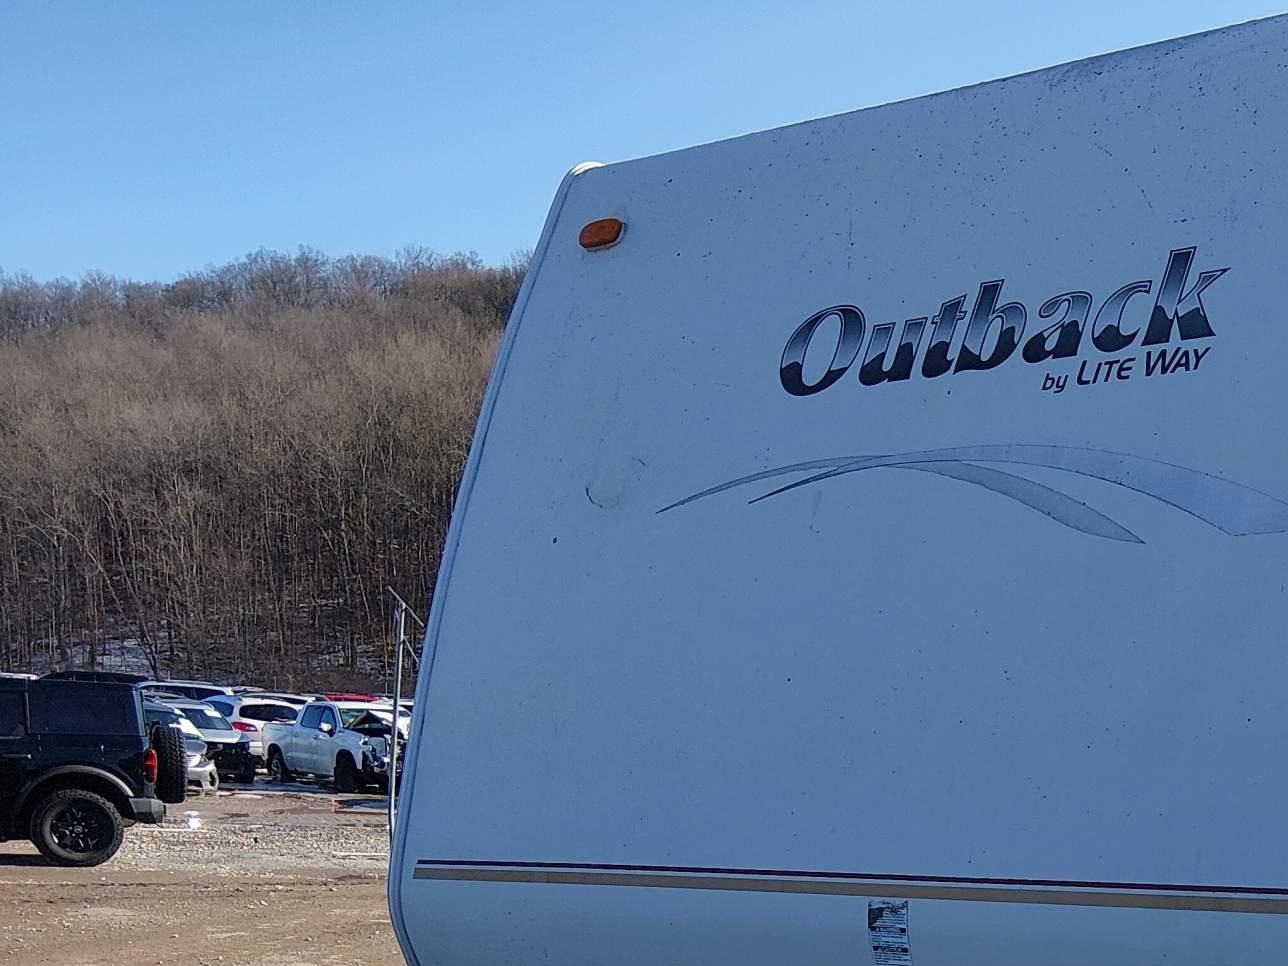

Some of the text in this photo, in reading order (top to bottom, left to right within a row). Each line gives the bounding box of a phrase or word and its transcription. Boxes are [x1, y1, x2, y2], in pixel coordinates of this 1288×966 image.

[780, 246, 1231, 396] Outback
[1041, 346, 1212, 394] by LITE WAY
